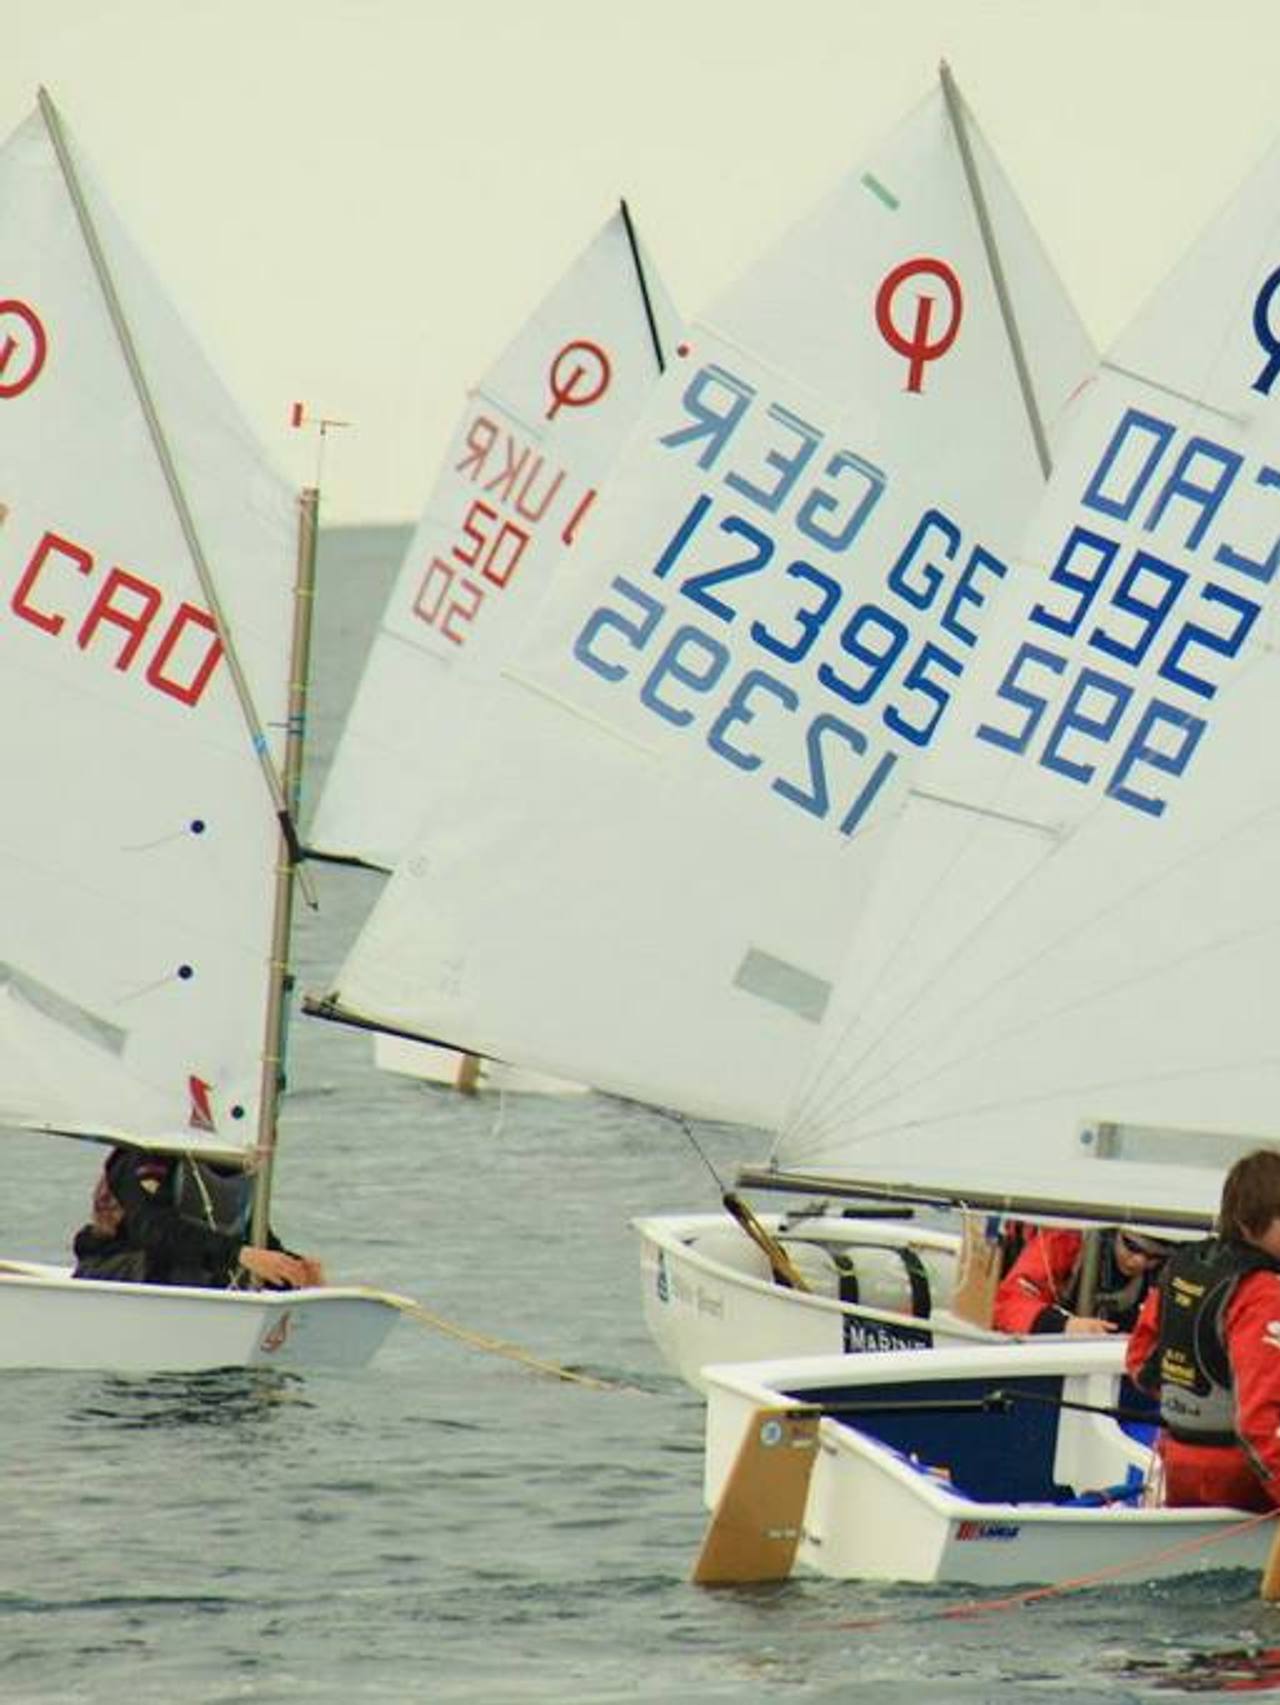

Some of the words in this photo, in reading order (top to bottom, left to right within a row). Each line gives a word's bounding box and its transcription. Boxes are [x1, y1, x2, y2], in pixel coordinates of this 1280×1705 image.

[453, 500, 530, 590] 50
[653, 494, 964, 747] 12395
[887, 509, 1008, 647] GE
[1028, 526, 1262, 700] 992
